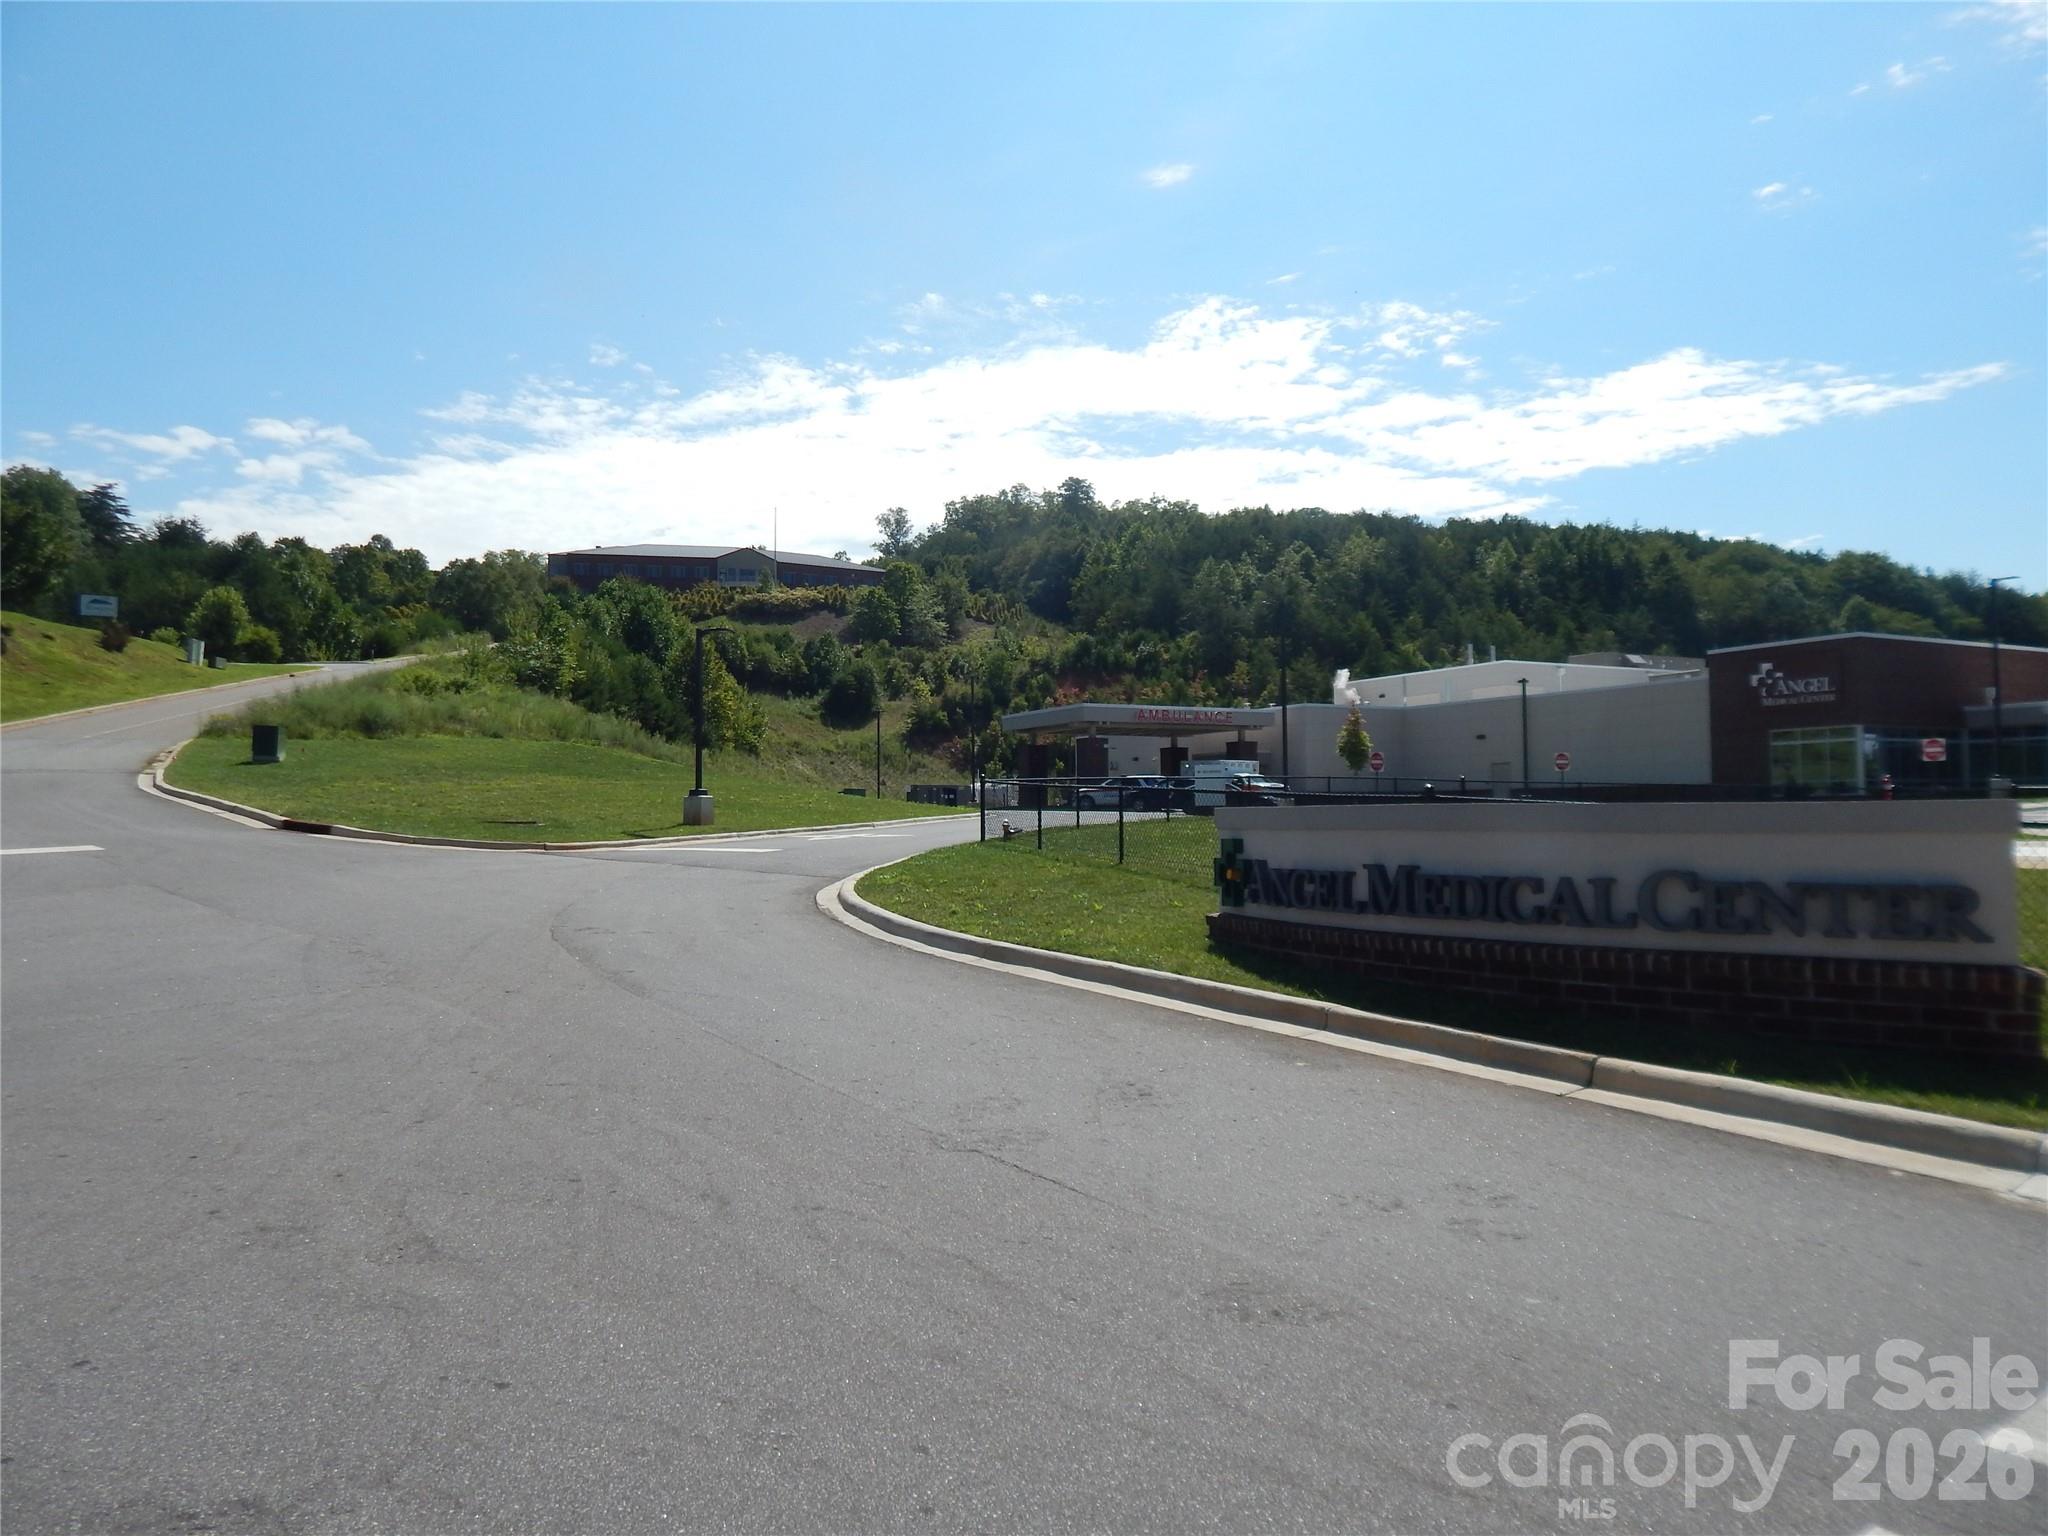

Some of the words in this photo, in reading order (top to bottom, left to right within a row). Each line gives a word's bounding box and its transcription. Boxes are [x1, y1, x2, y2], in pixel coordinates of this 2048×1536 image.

[1776, 677, 1837, 695] ANGEL
[1136, 708, 1233, 723] AMBULANCE
[1245, 858, 1366, 914] ANGEL
[1362, 863, 1639, 929] MEDICAL
[1637, 868, 1996, 944] CENTER
